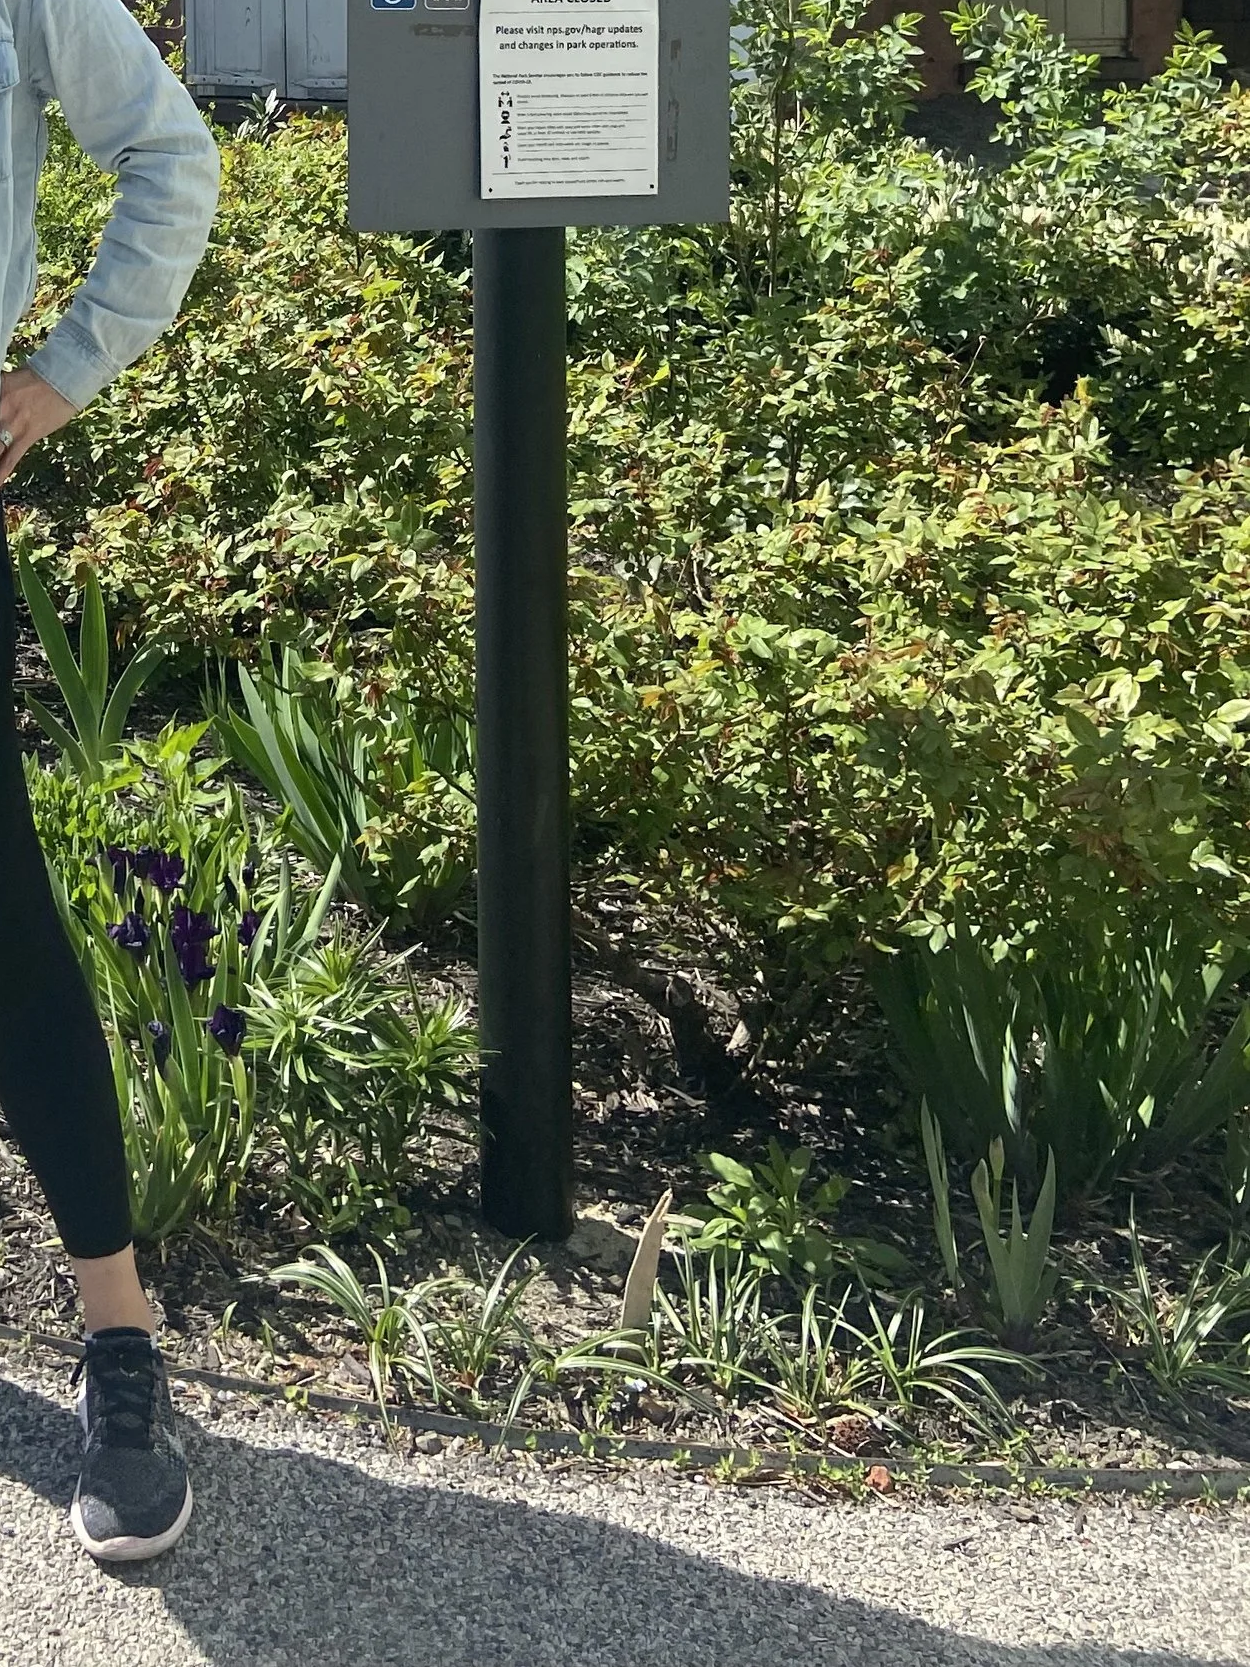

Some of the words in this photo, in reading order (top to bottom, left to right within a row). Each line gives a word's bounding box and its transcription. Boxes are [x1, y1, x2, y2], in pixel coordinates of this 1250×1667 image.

[495, 26, 524, 35] Please
[526, 25, 544, 34] visit
[547, 24, 606, 36] nps.gov/hagr
[607, 24, 643, 35] updates
[499, 40, 516, 50] and
[518, 40, 554, 51] changes
[556, 39, 565, 49] in
[566, 39, 587, 51] park
[588, 39, 639, 50] operations.
